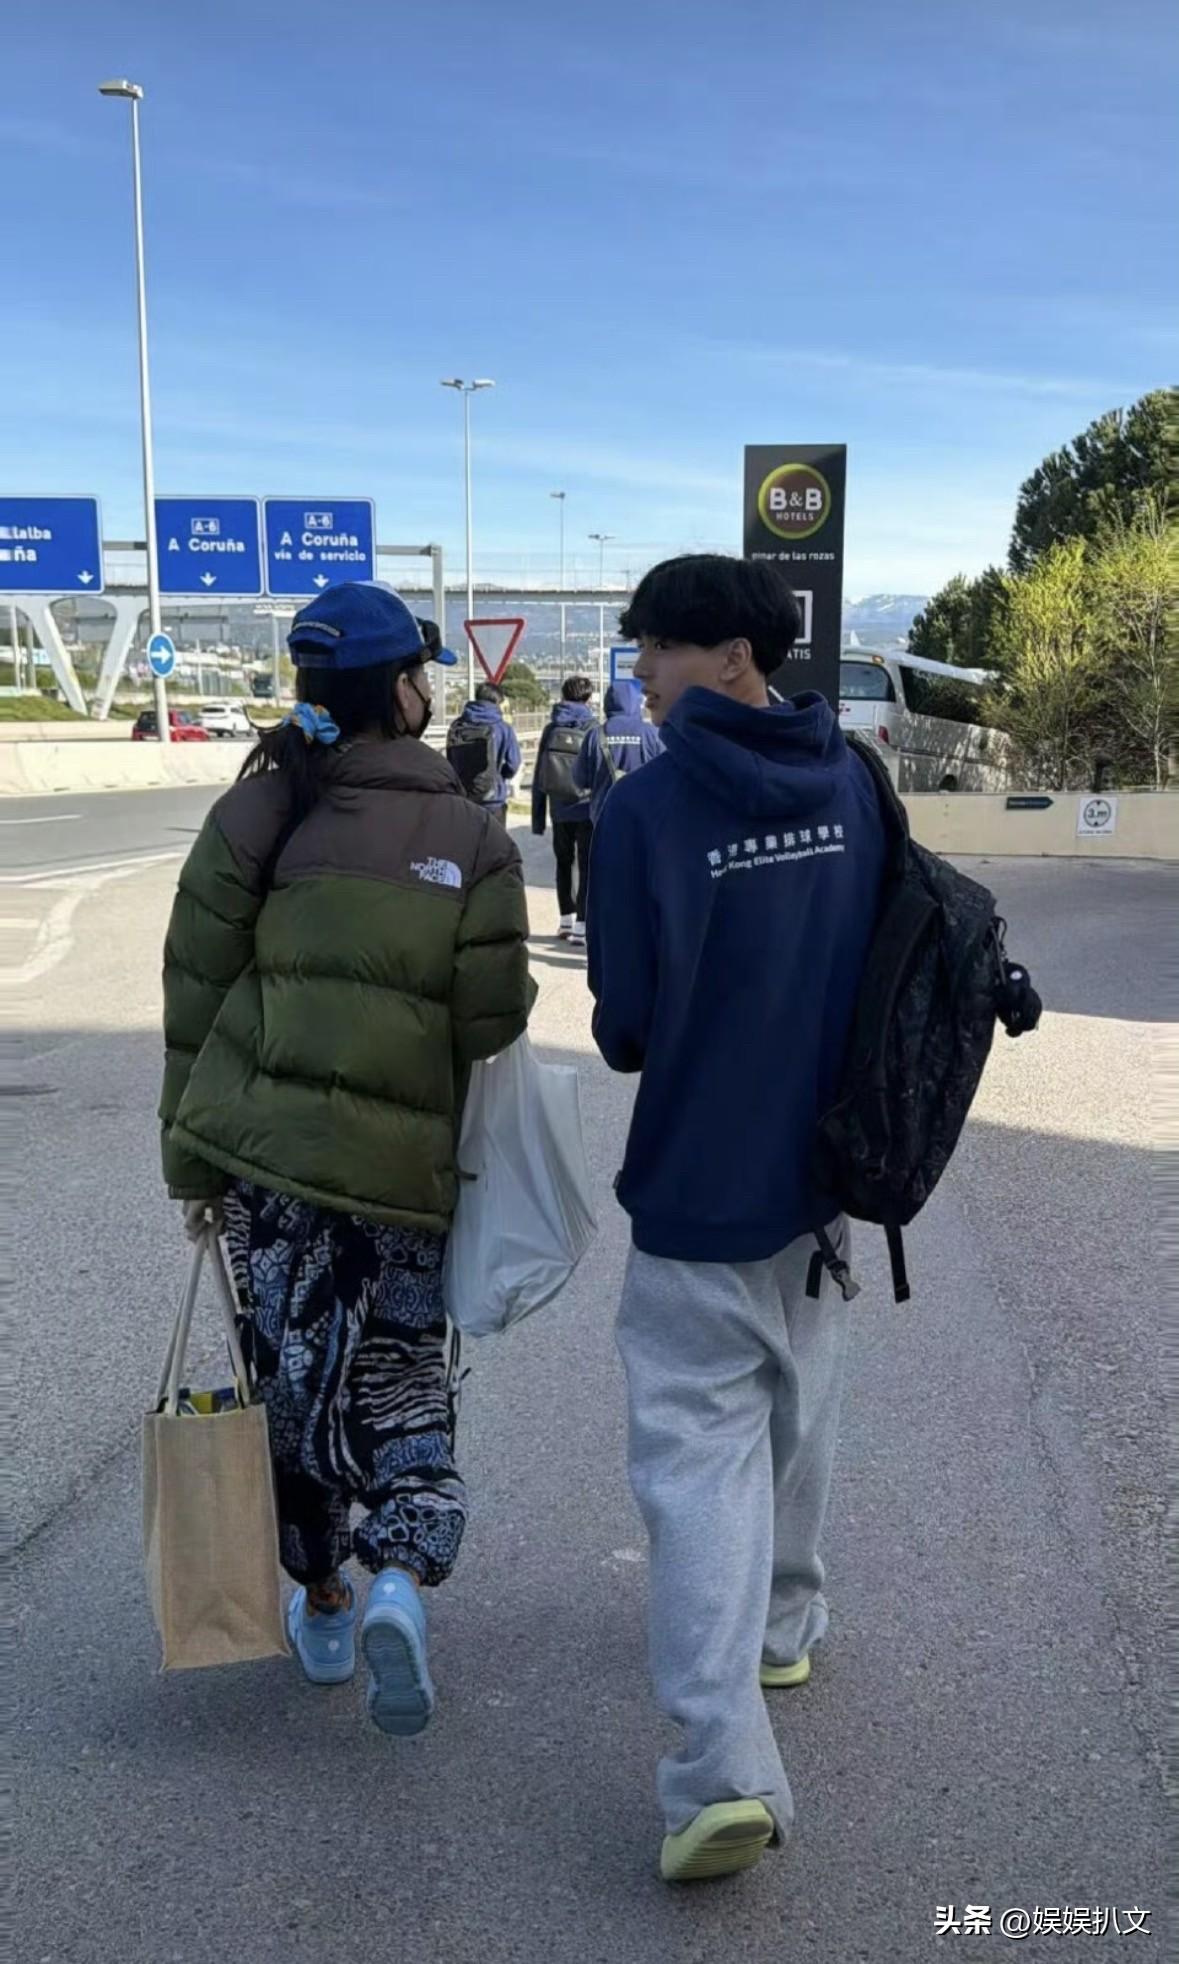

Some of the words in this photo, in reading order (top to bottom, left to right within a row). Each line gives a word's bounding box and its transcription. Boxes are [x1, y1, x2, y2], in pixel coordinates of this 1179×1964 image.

[769, 487, 822, 511] B&B
[308, 514, 330, 528] A-6
[776, 512, 815, 521] HOTELS
[195, 520, 217, 533] A-6
[168, 537, 180, 552] A
[188, 537, 246, 553] Coruña
[281, 531, 293, 546] A
[301, 531, 359, 547] Coruña
[298, 549, 314, 561] de
[320, 549, 367, 562] servicio
[779, 551, 790, 561] de
[792, 551, 807, 561] las
[809, 551, 835, 561] rozas
[786, 648, 812, 660] ATIS
[427, 856, 447, 868] THE
[728, 859, 753, 870] Kong
[753, 855, 775, 867] Elite
[774, 847, 815, 863] Volleyball
[814, 844, 846, 854] Academy
[409, 861, 446, 876] NORTH
[419, 870, 448, 884] FACE
